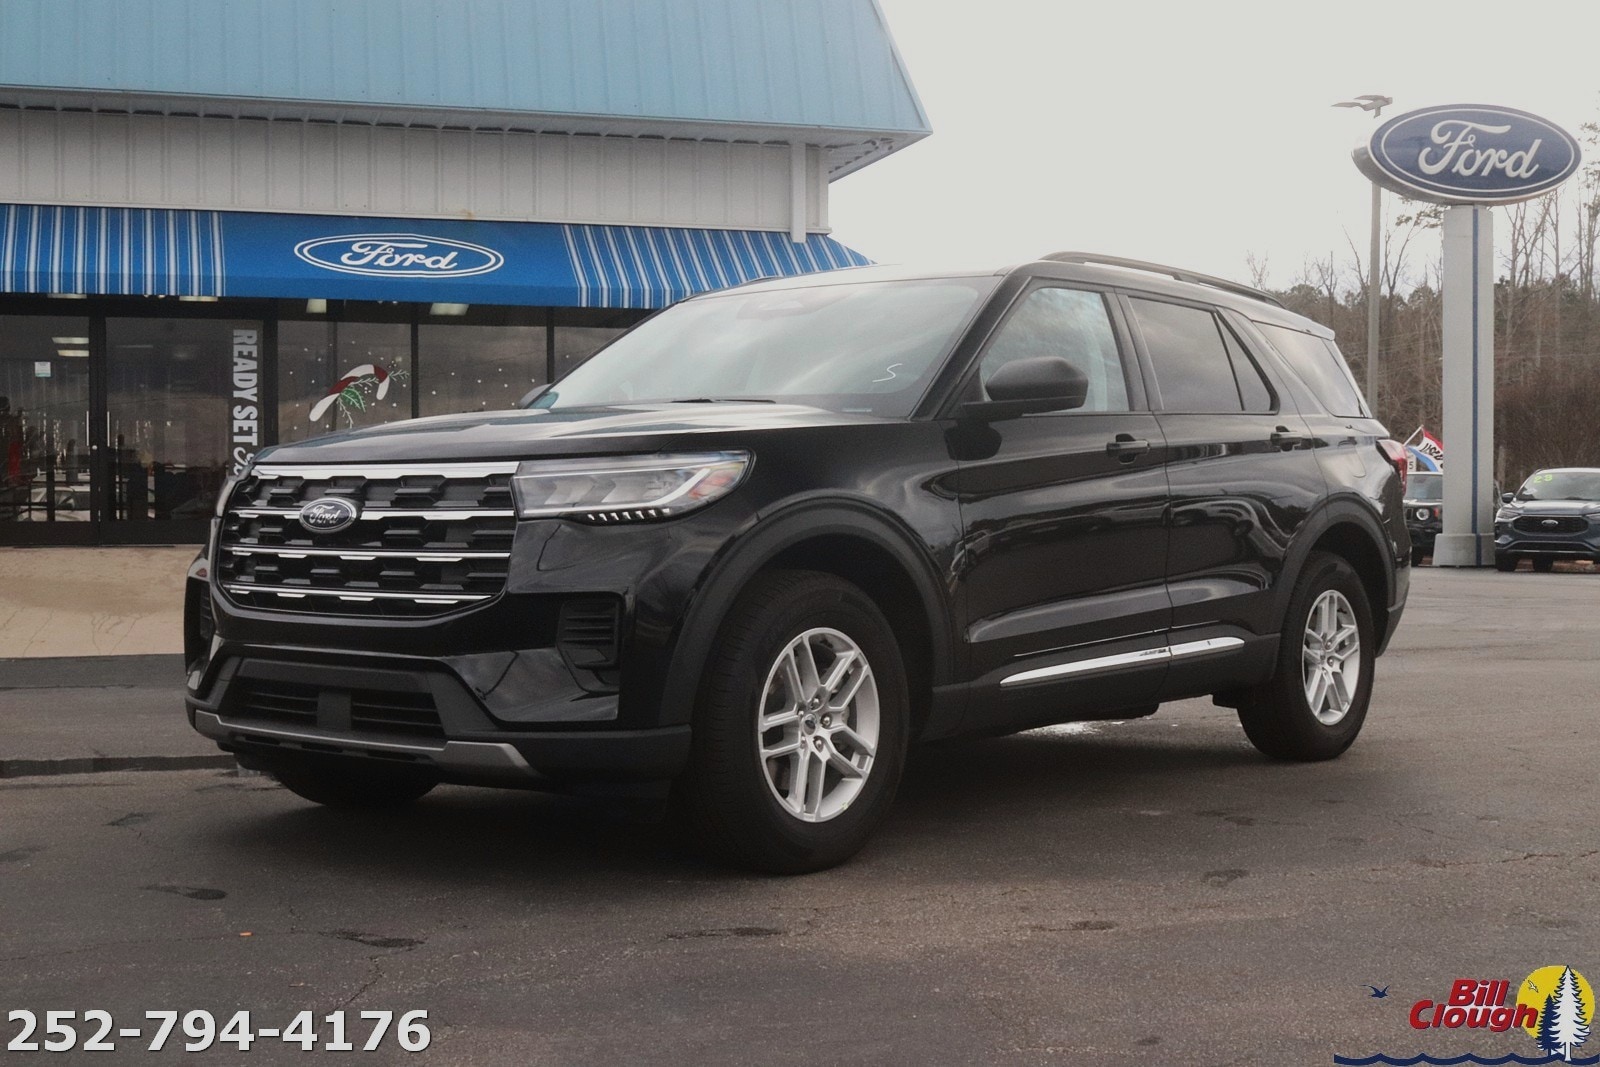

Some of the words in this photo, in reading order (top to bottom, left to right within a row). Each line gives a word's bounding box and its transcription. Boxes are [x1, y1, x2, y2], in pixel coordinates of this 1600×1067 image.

[1418, 119, 1543, 179] Ford
[340, 241, 458, 269] Ford
[232, 329, 258, 403] READY
[232, 404, 258, 446] SET
[309, 504, 342, 525] Ford
